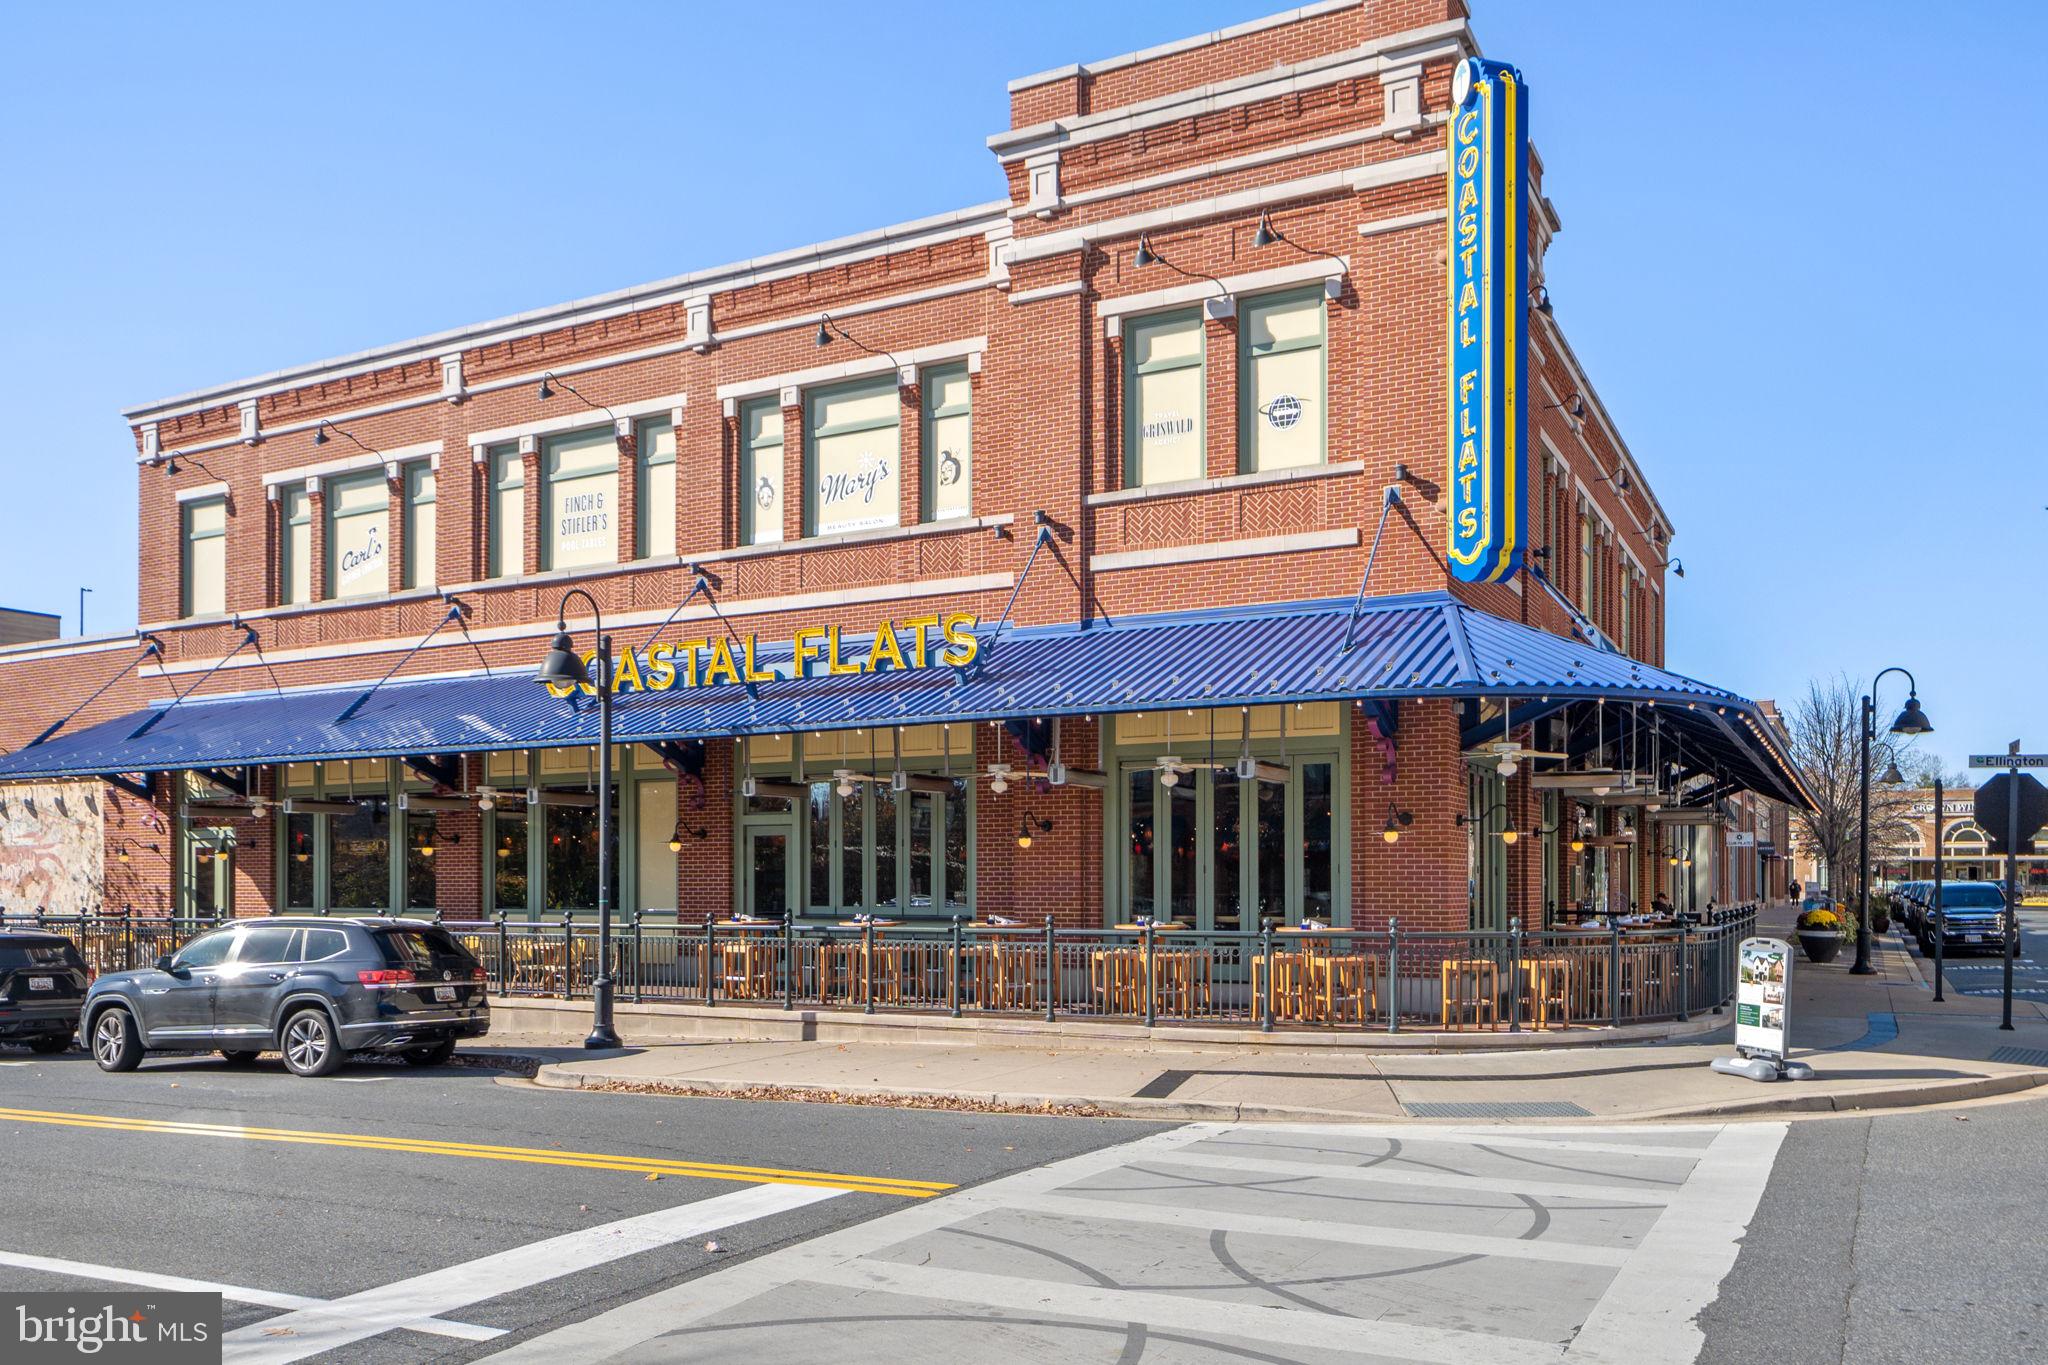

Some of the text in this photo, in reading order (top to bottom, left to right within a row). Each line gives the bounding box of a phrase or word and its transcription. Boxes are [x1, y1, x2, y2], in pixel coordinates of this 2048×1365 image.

[1457, 110, 1479, 538] COASTAL FLATS
[821, 459, 890, 505] Mary's
[565, 492, 604, 513] FINCH &
[561, 513, 607, 535] STIFLER'S
[827, 522, 855, 530] BEAUTY
[342, 536, 382, 571] Carl's
[795, 613, 979, 678] FLATS
[1986, 756, 2043, 768] Ellington
[1912, 803, 1956, 813] CRON
